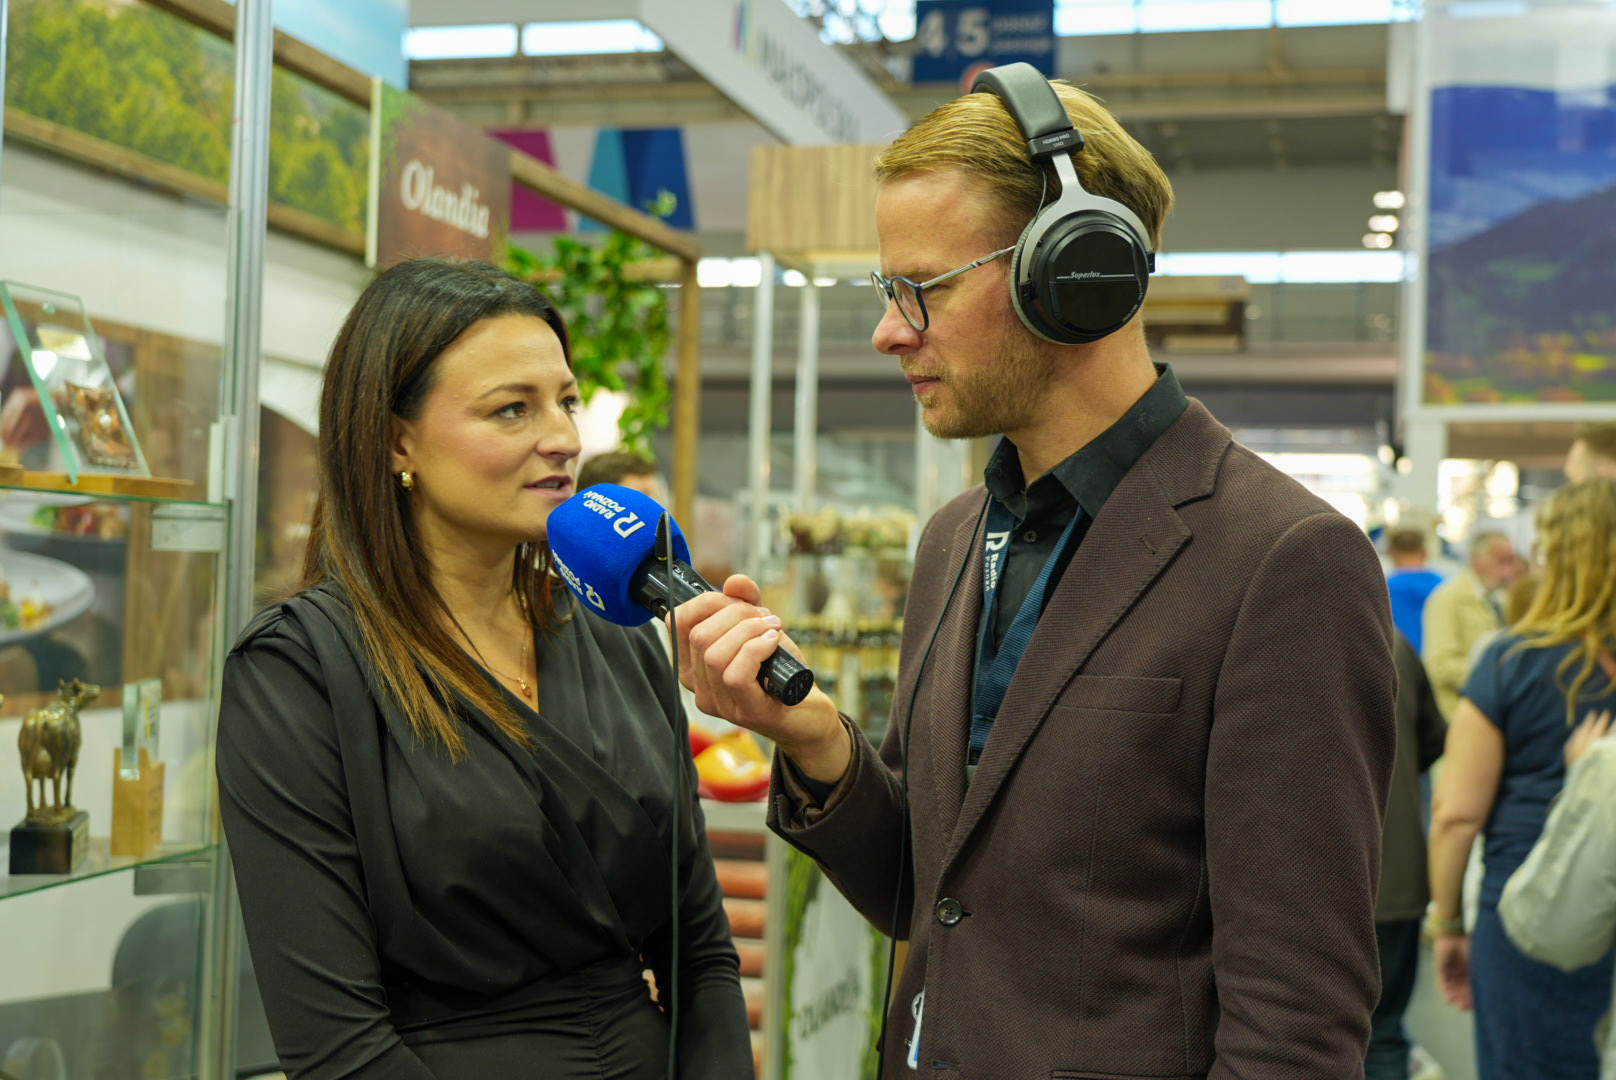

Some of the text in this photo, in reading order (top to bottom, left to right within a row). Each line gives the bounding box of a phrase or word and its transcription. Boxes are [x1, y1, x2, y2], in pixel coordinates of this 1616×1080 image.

[918, 8, 990, 57] 4 5
[401, 158, 489, 240] Olandia
[1070, 271, 1101, 280] Superlux
[583, 499, 616, 520] RADIO
[990, 553, 999, 589] Radio
